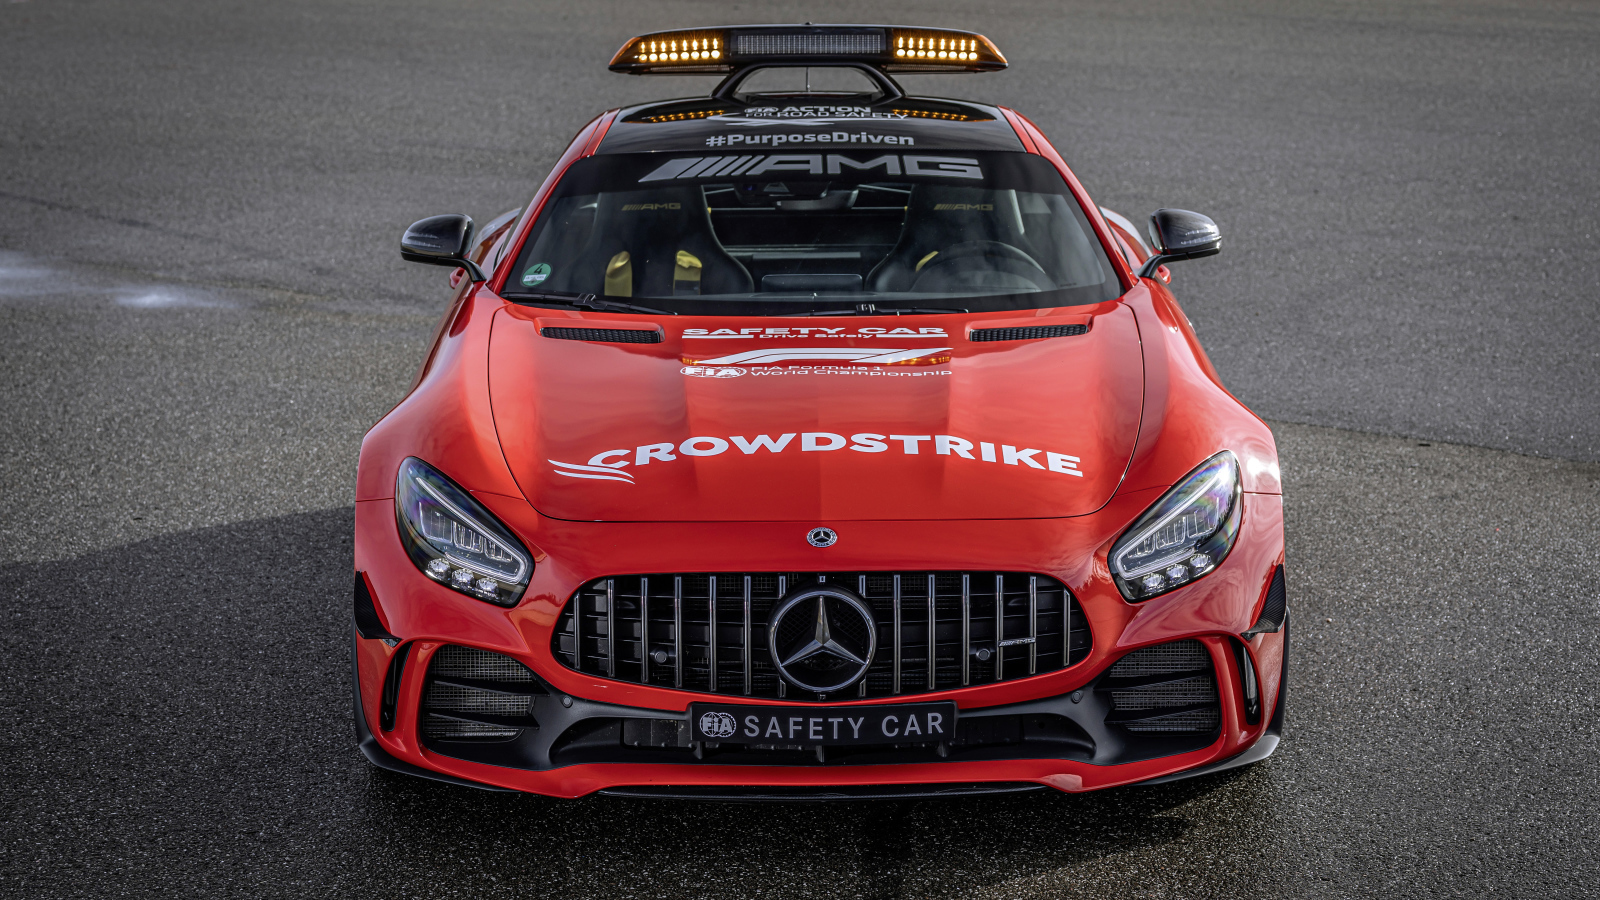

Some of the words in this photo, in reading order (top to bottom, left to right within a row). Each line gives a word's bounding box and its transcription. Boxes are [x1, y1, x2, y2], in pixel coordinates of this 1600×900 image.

[706, 132, 915, 147] #PurposeDriven
[682, 327, 845, 335] SAFETY
[682, 366, 746, 378] FIA
[814, 369, 953, 377] Championship
[588, 432, 1084, 478] CROWDSTRIKE
[744, 715, 865, 740] SAFETY
[881, 712, 945, 738] CAR
